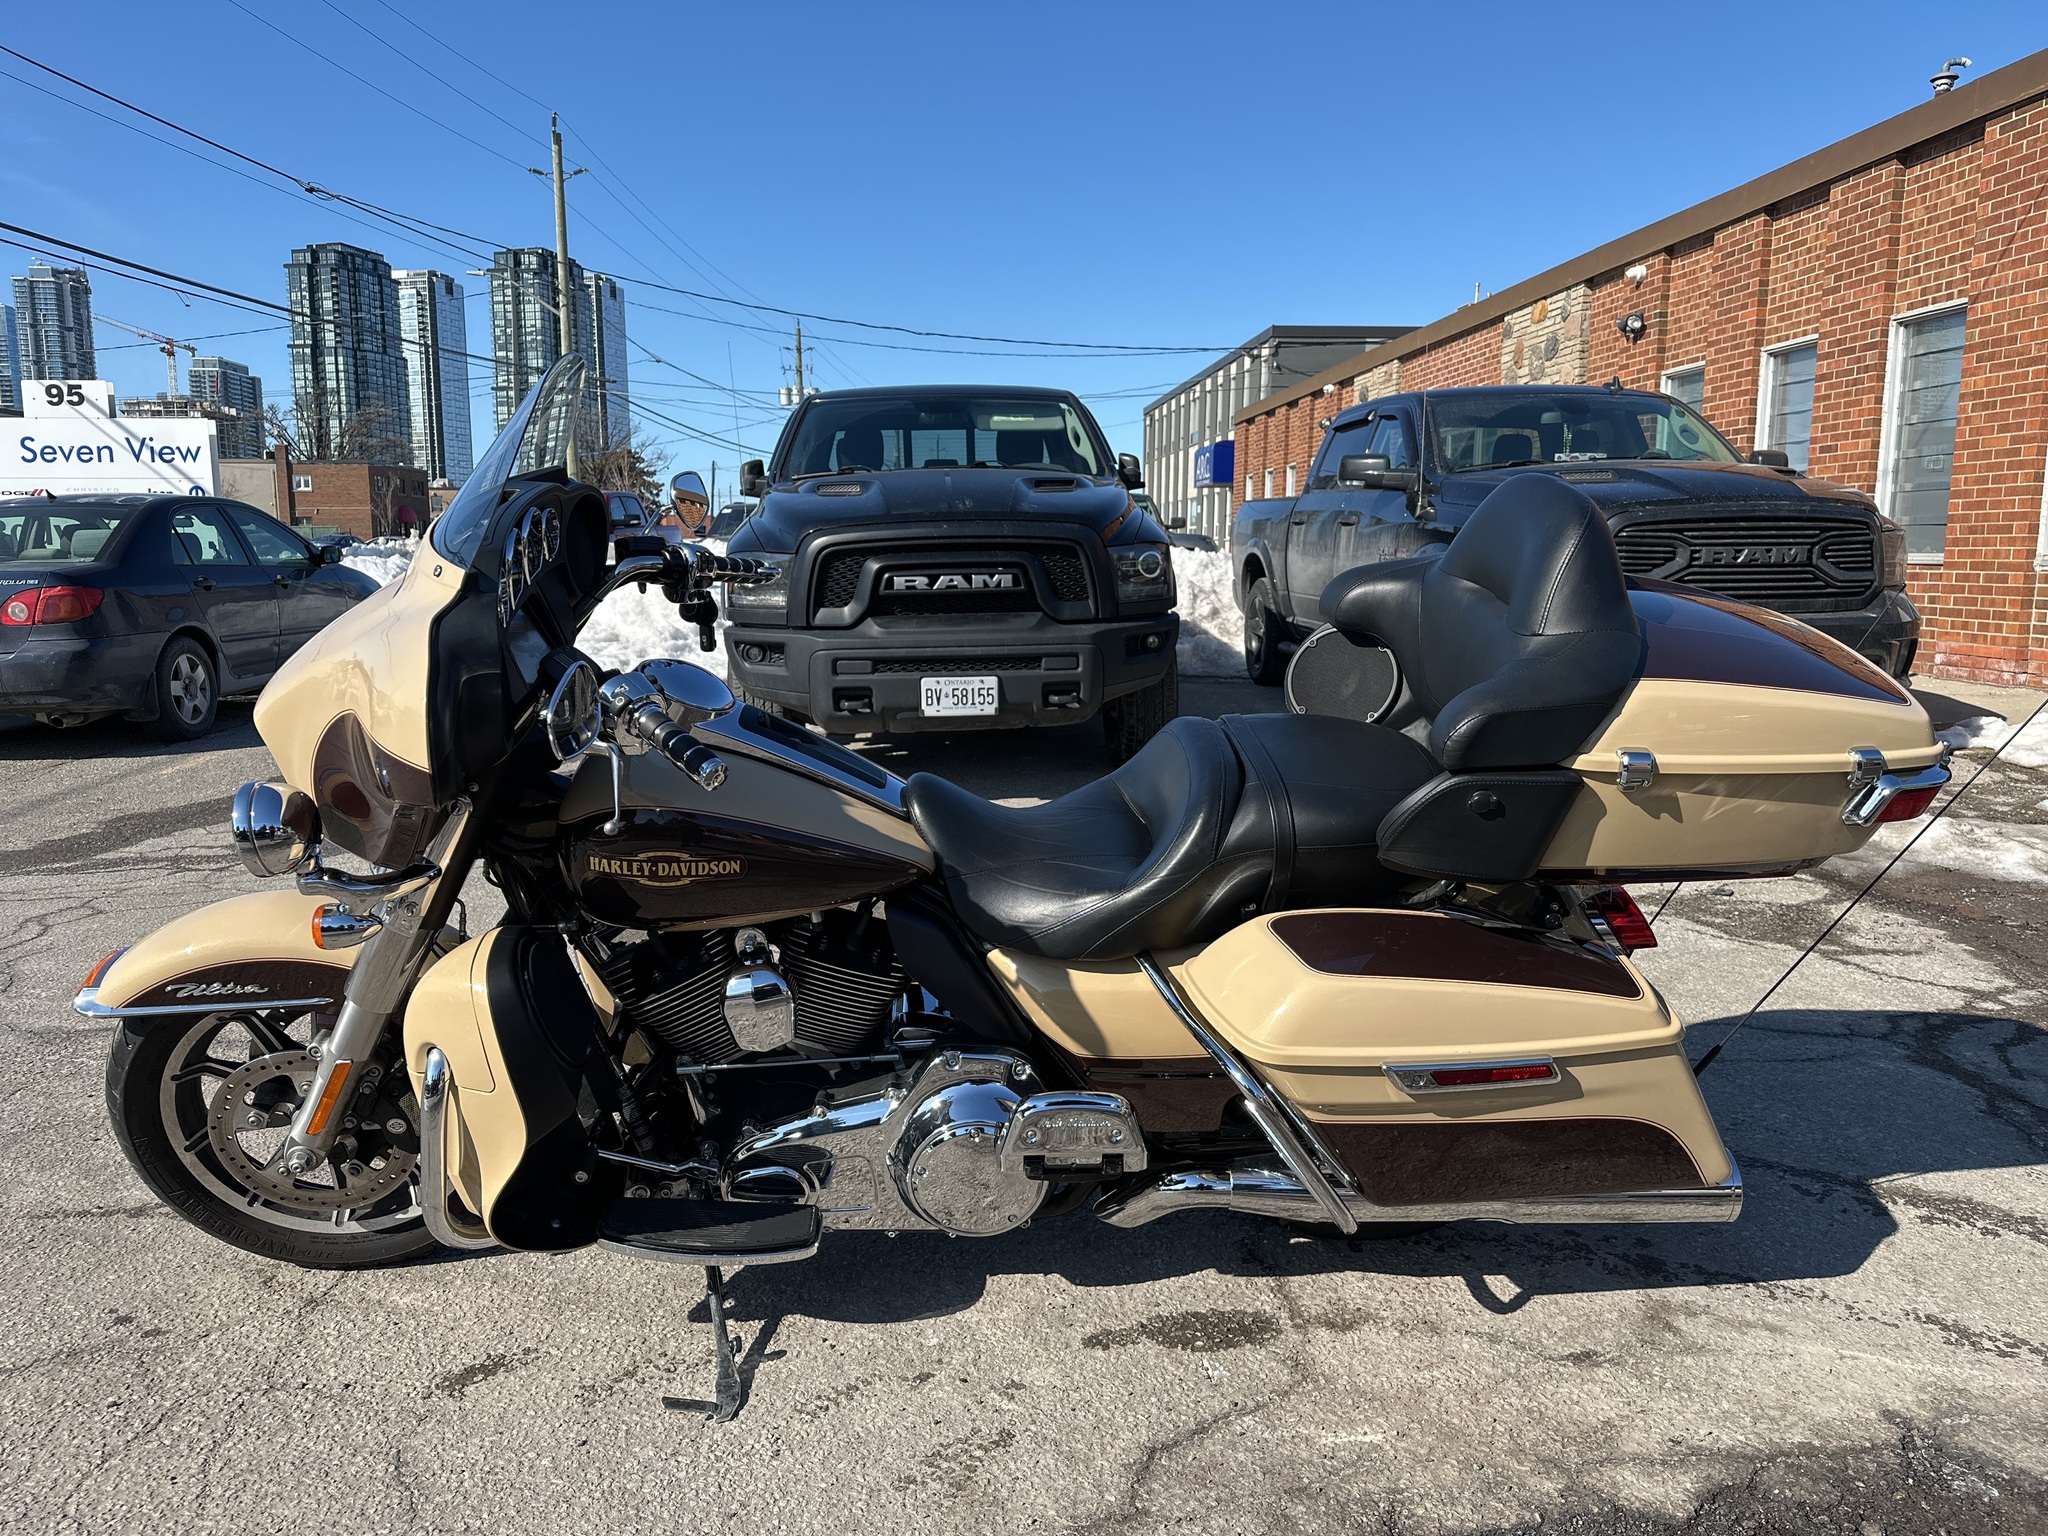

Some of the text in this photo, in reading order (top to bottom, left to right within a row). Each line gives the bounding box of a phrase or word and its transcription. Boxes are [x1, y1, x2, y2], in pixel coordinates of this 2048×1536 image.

[44, 384, 85, 407] 95
[20, 436, 202, 464] Seven View
[1700, 546, 1810, 565] RAM
[893, 574, 1013, 590] RAM
[925, 687, 995, 706] BV 58155
[164, 982, 269, 998] Ultra
[169, 1189, 295, 1258] AMERICAN
